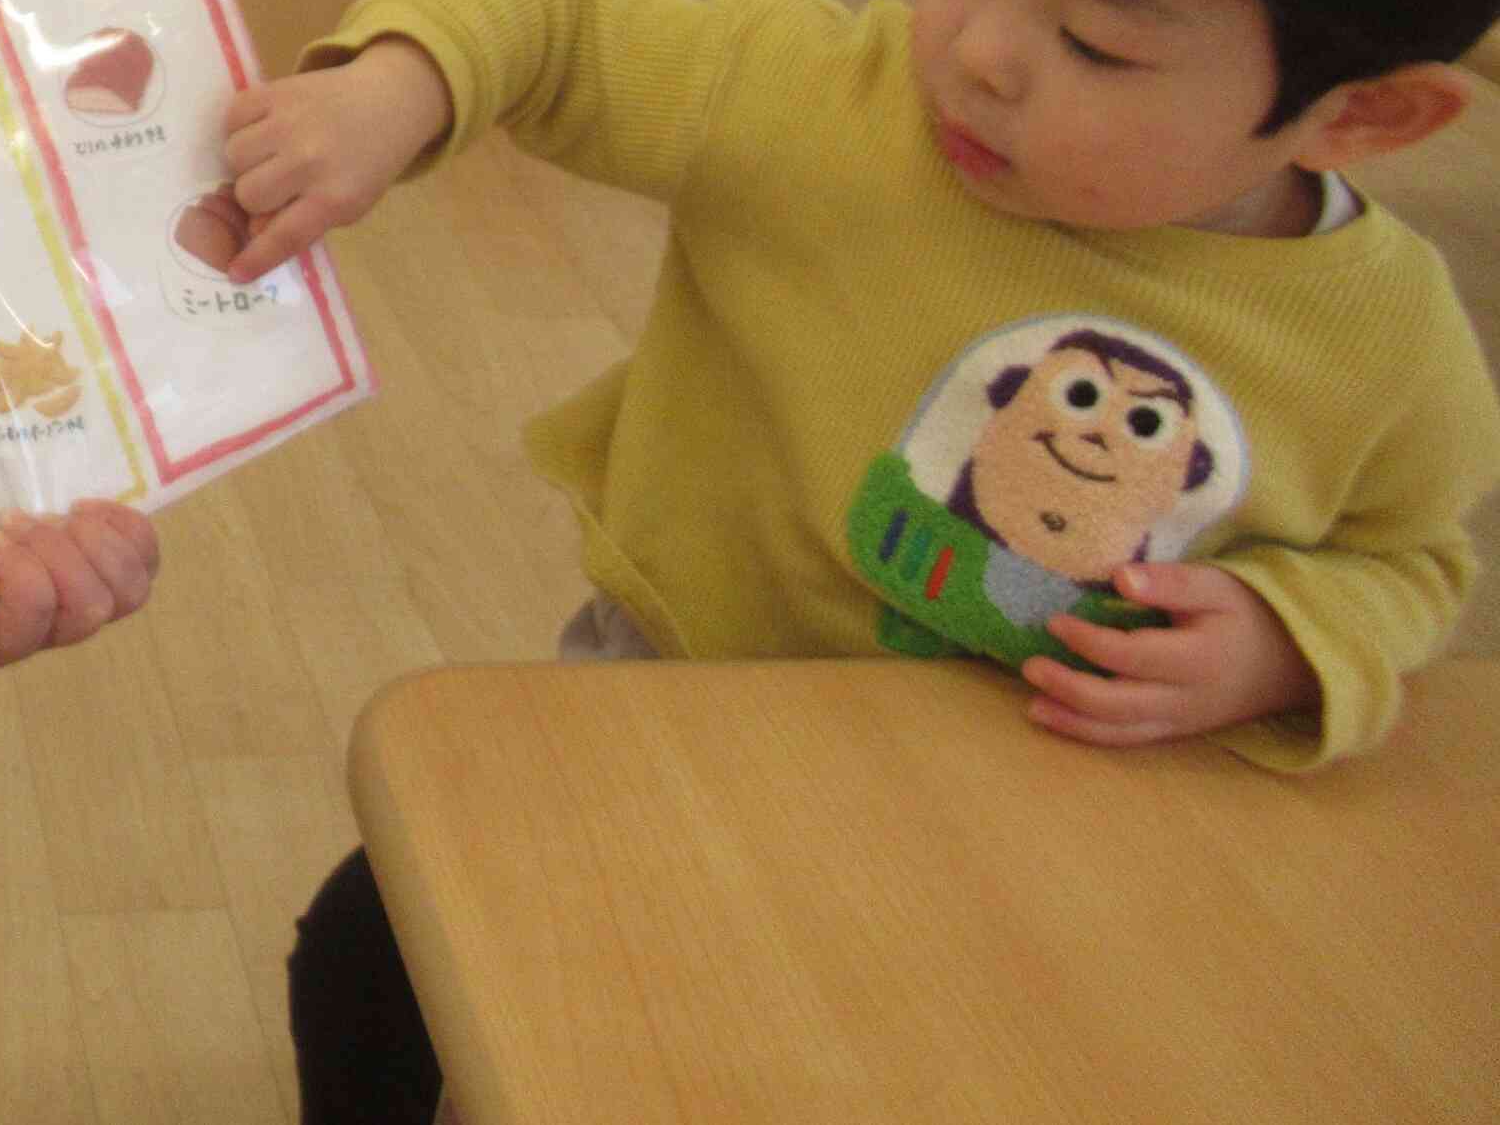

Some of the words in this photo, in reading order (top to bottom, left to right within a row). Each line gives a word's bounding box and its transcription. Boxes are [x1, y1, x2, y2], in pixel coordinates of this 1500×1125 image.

[182, 282, 278, 314] ミートローフ
